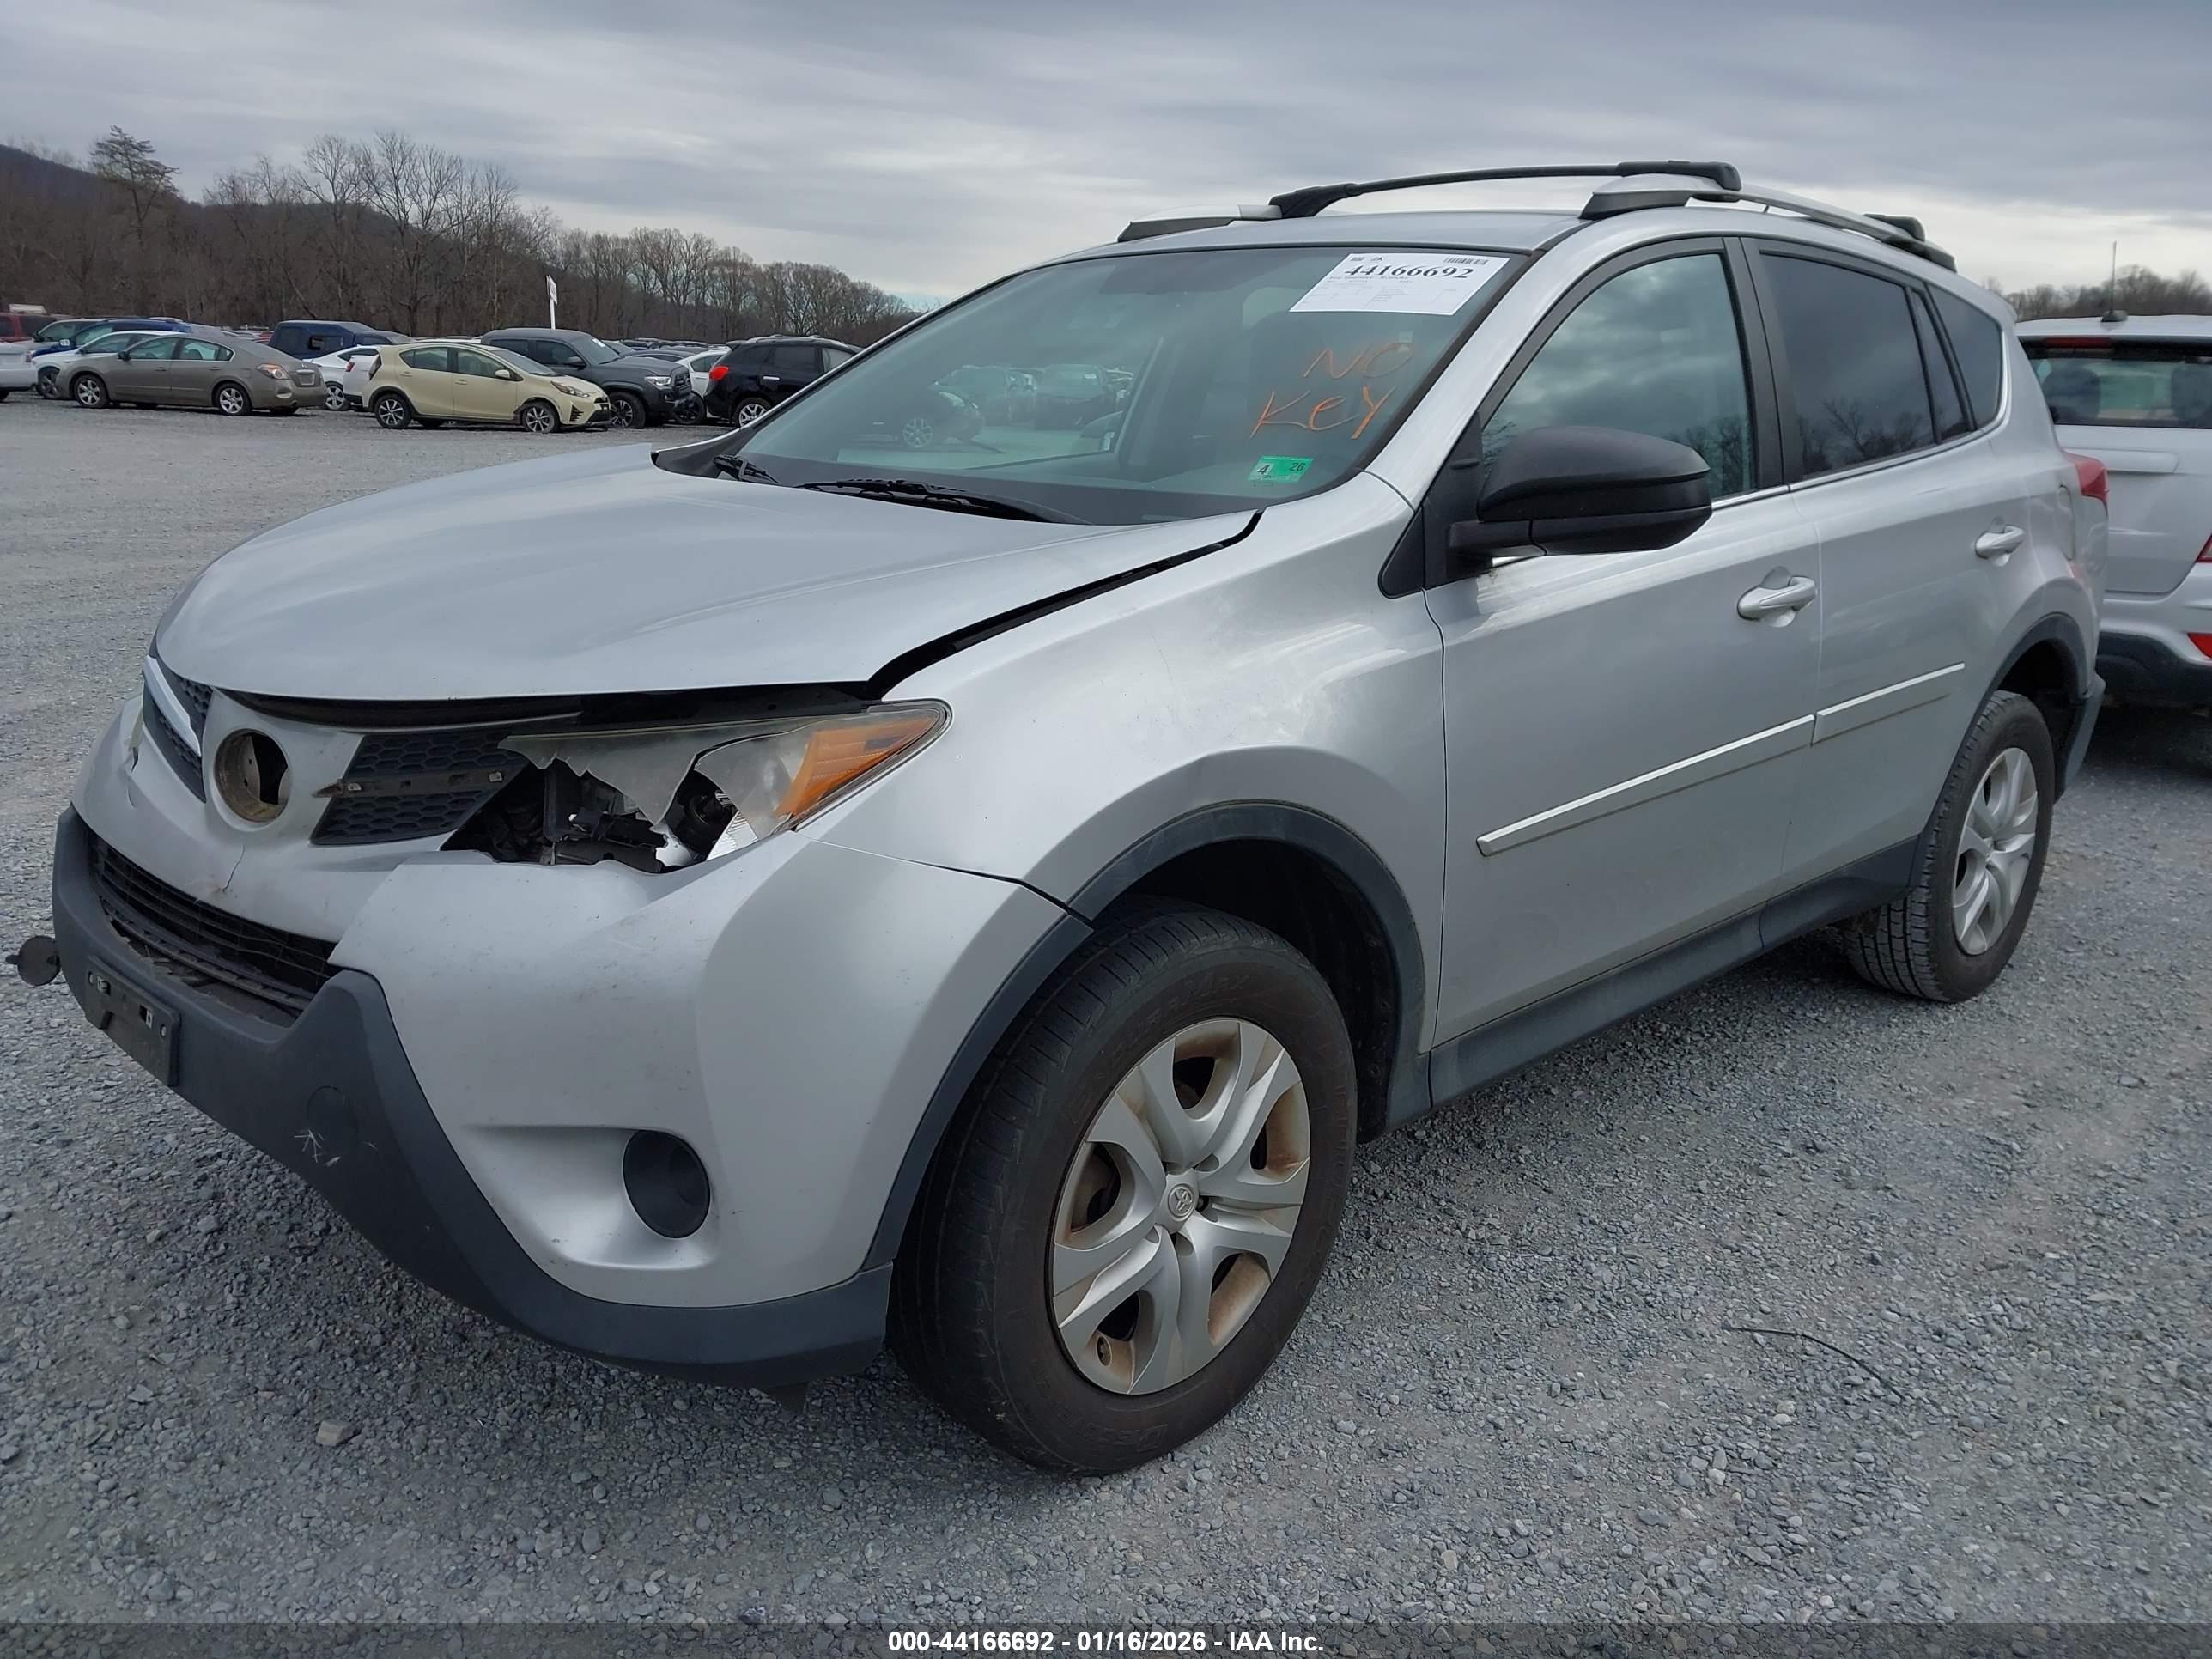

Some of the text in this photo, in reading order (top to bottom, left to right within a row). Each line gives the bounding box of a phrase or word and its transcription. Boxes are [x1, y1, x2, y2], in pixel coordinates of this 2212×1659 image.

[1344, 264, 1474, 279] 44166692
[1302, 341, 1415, 379] NO
[1289, 462, 1306, 472] 26
